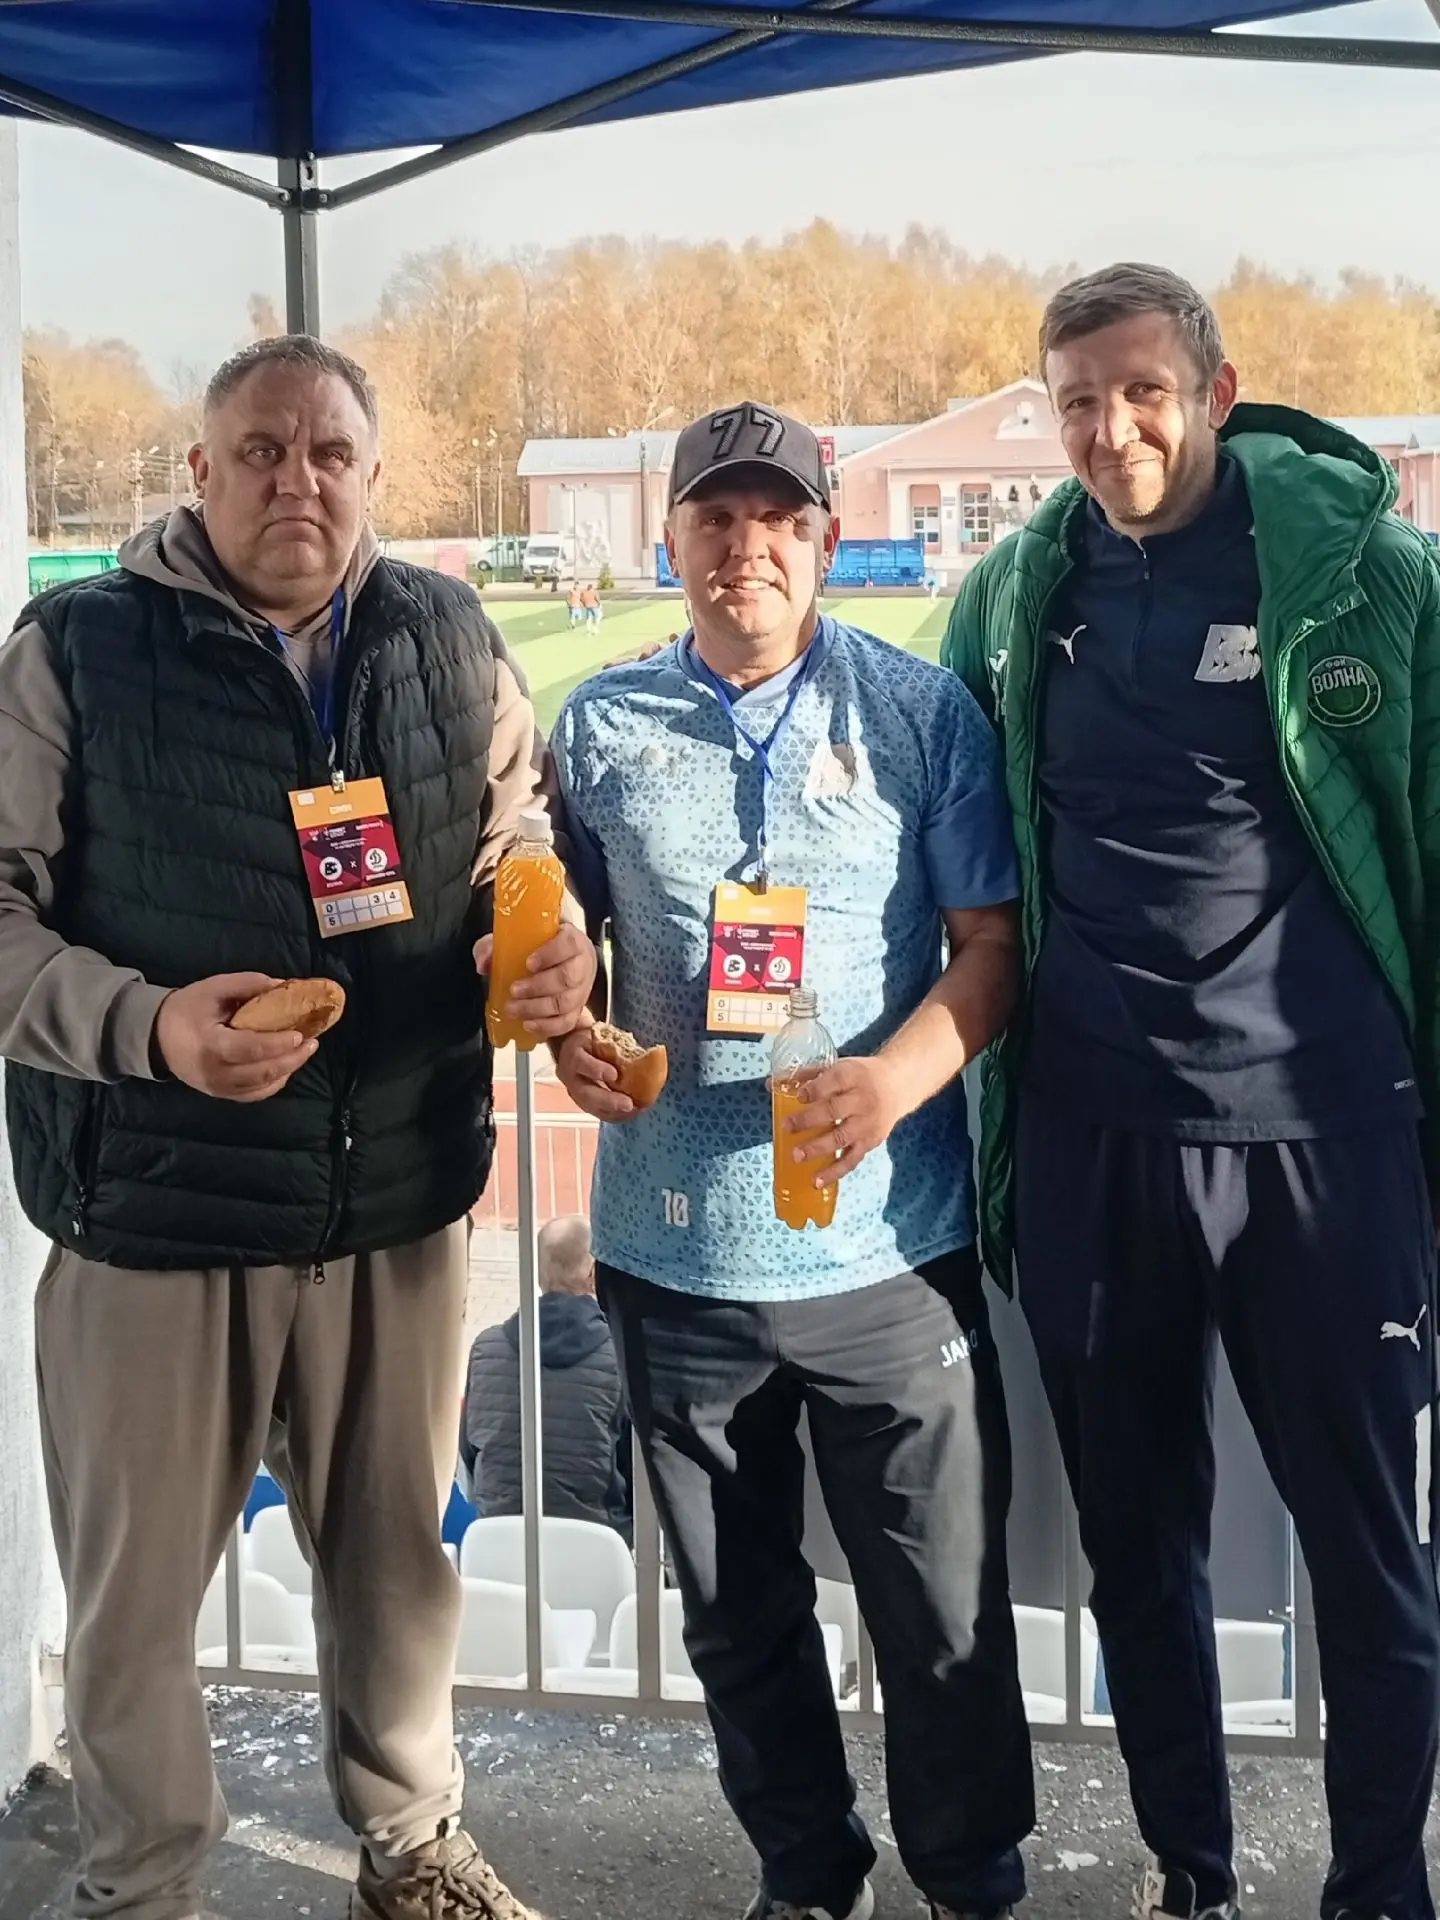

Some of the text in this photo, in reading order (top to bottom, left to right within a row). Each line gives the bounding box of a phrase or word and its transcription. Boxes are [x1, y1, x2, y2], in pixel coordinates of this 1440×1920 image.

[710, 406, 787, 460] 77
[1311, 666, 1369, 695] ВОЛНА
[326, 891, 396, 913] 0 3 4
[329, 917, 336, 926] 5
[718, 999, 789, 1012] 0 3 4
[718, 1013, 724, 1021] 5
[660, 1187, 689, 1228] 10
[940, 1328, 978, 1368] JAKO
